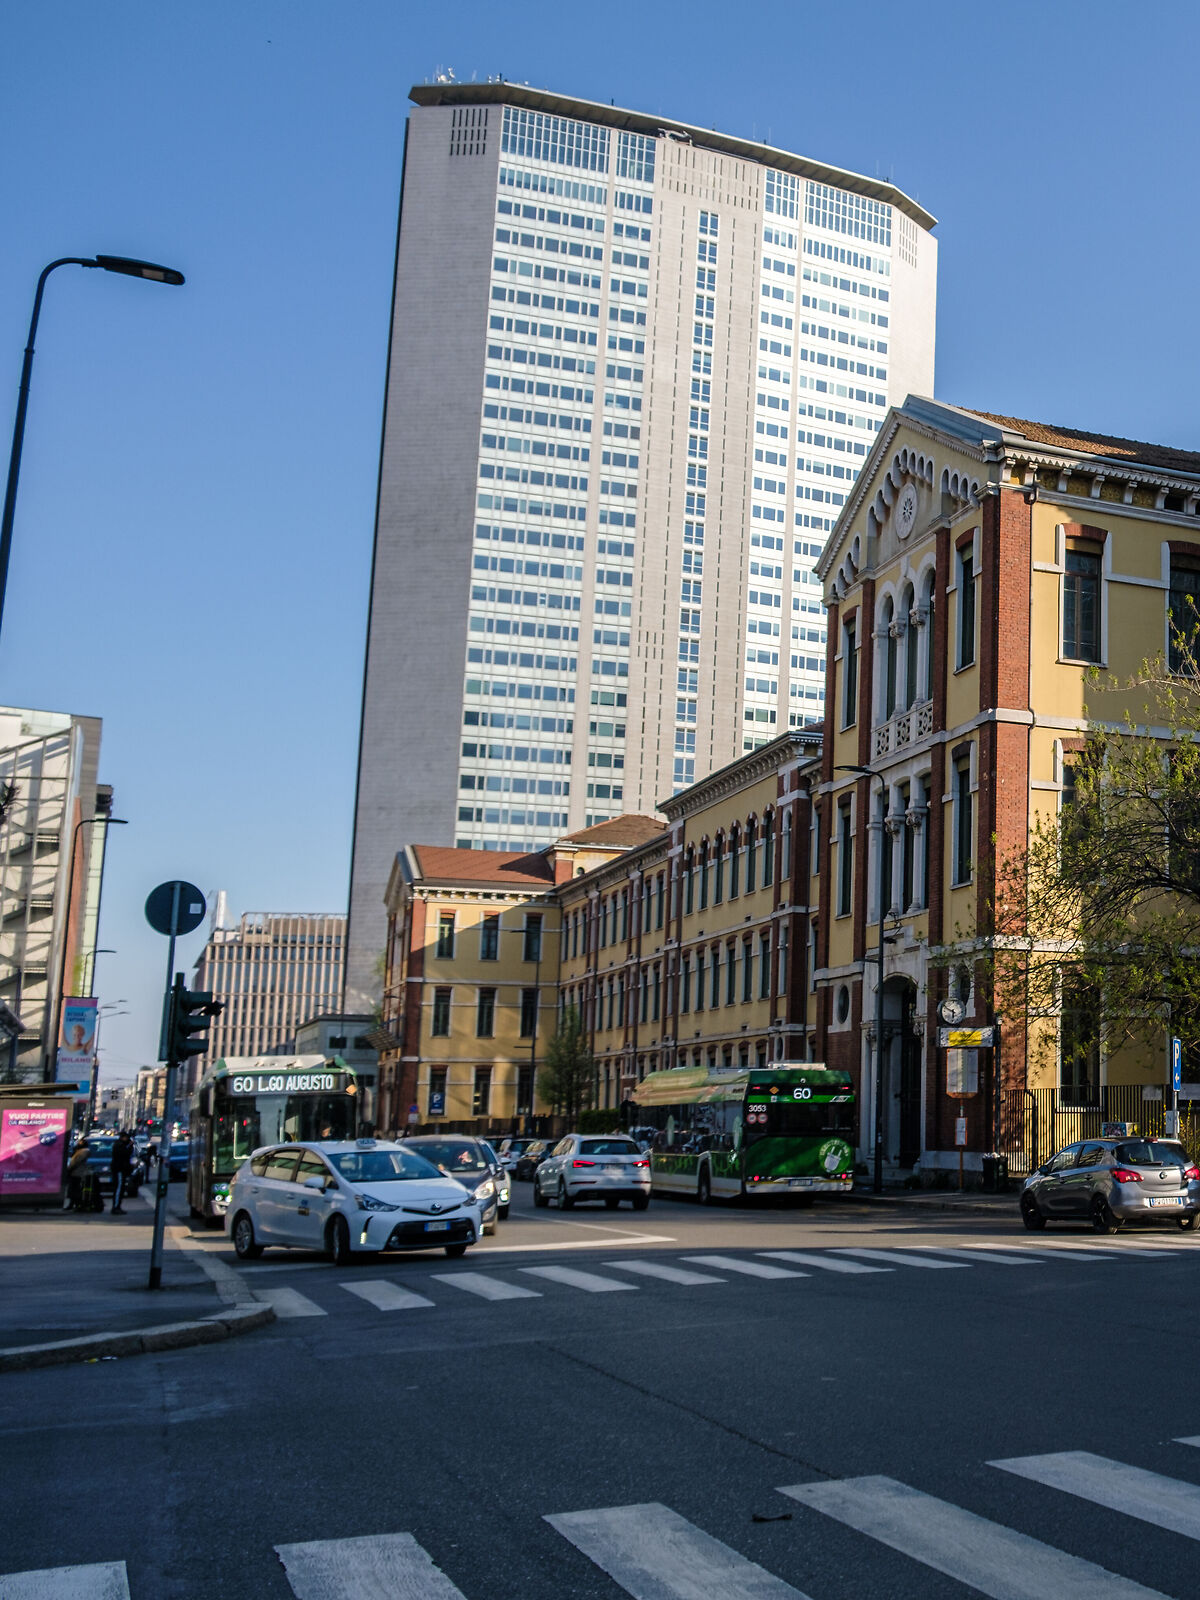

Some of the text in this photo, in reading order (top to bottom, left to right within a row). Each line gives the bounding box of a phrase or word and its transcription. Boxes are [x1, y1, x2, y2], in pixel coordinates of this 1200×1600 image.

[1174, 1043, 1180, 1068] P
[233, 1074, 334, 1093] 60 L.GO AUGUSTO
[433, 1094, 441, 1104] P
[793, 1087, 811, 1100] 60
[748, 1104, 767, 1112] 3053
[8, 1112, 65, 1120] VUOI PARTIRE
